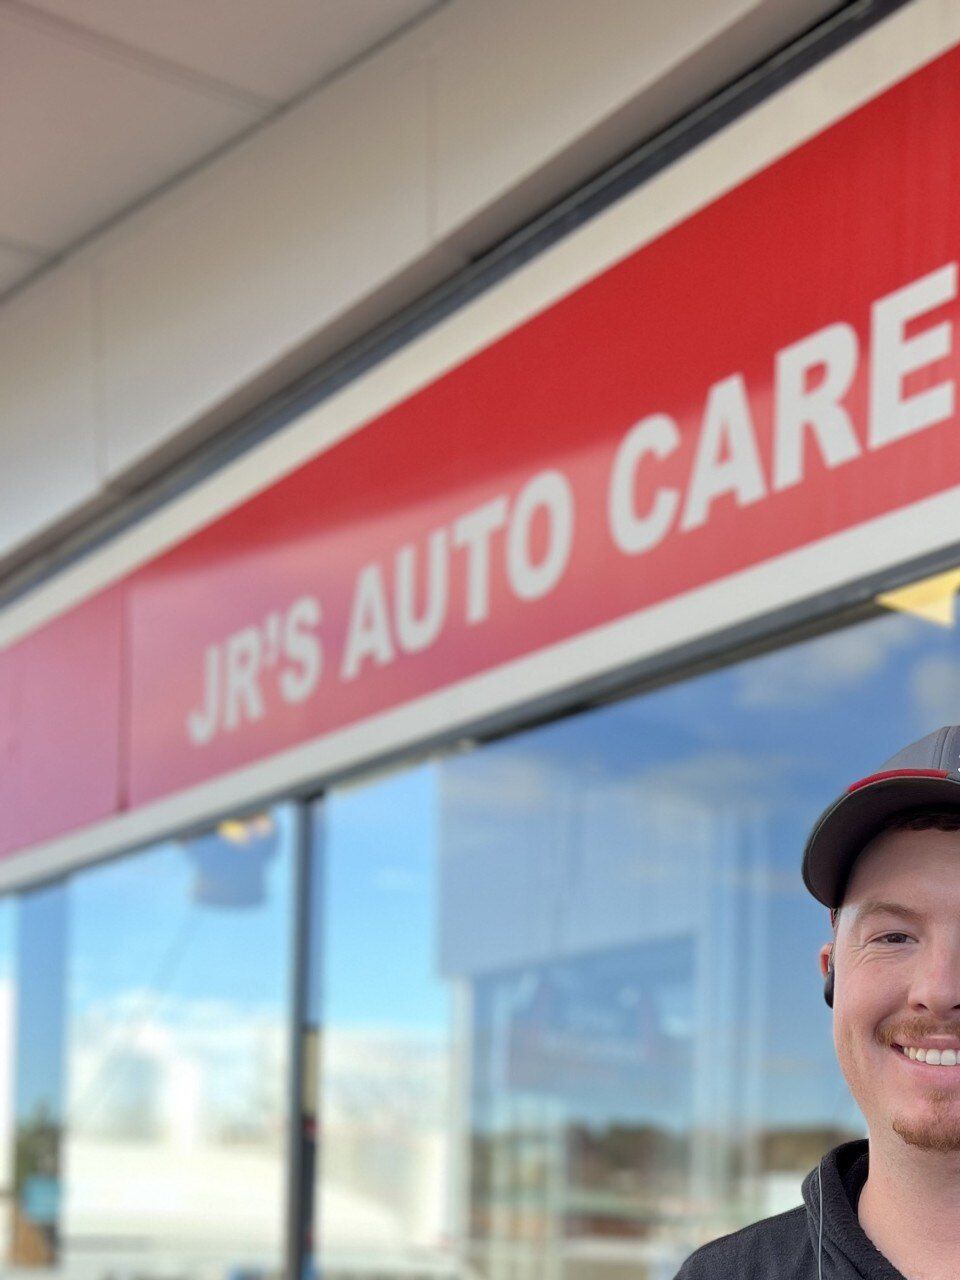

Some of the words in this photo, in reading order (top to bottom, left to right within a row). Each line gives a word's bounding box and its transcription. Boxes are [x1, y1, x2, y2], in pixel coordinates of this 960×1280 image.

[187, 589, 321, 747] JR'S
[341, 469, 574, 683] AUTO
[607, 262, 958, 556] CARE
